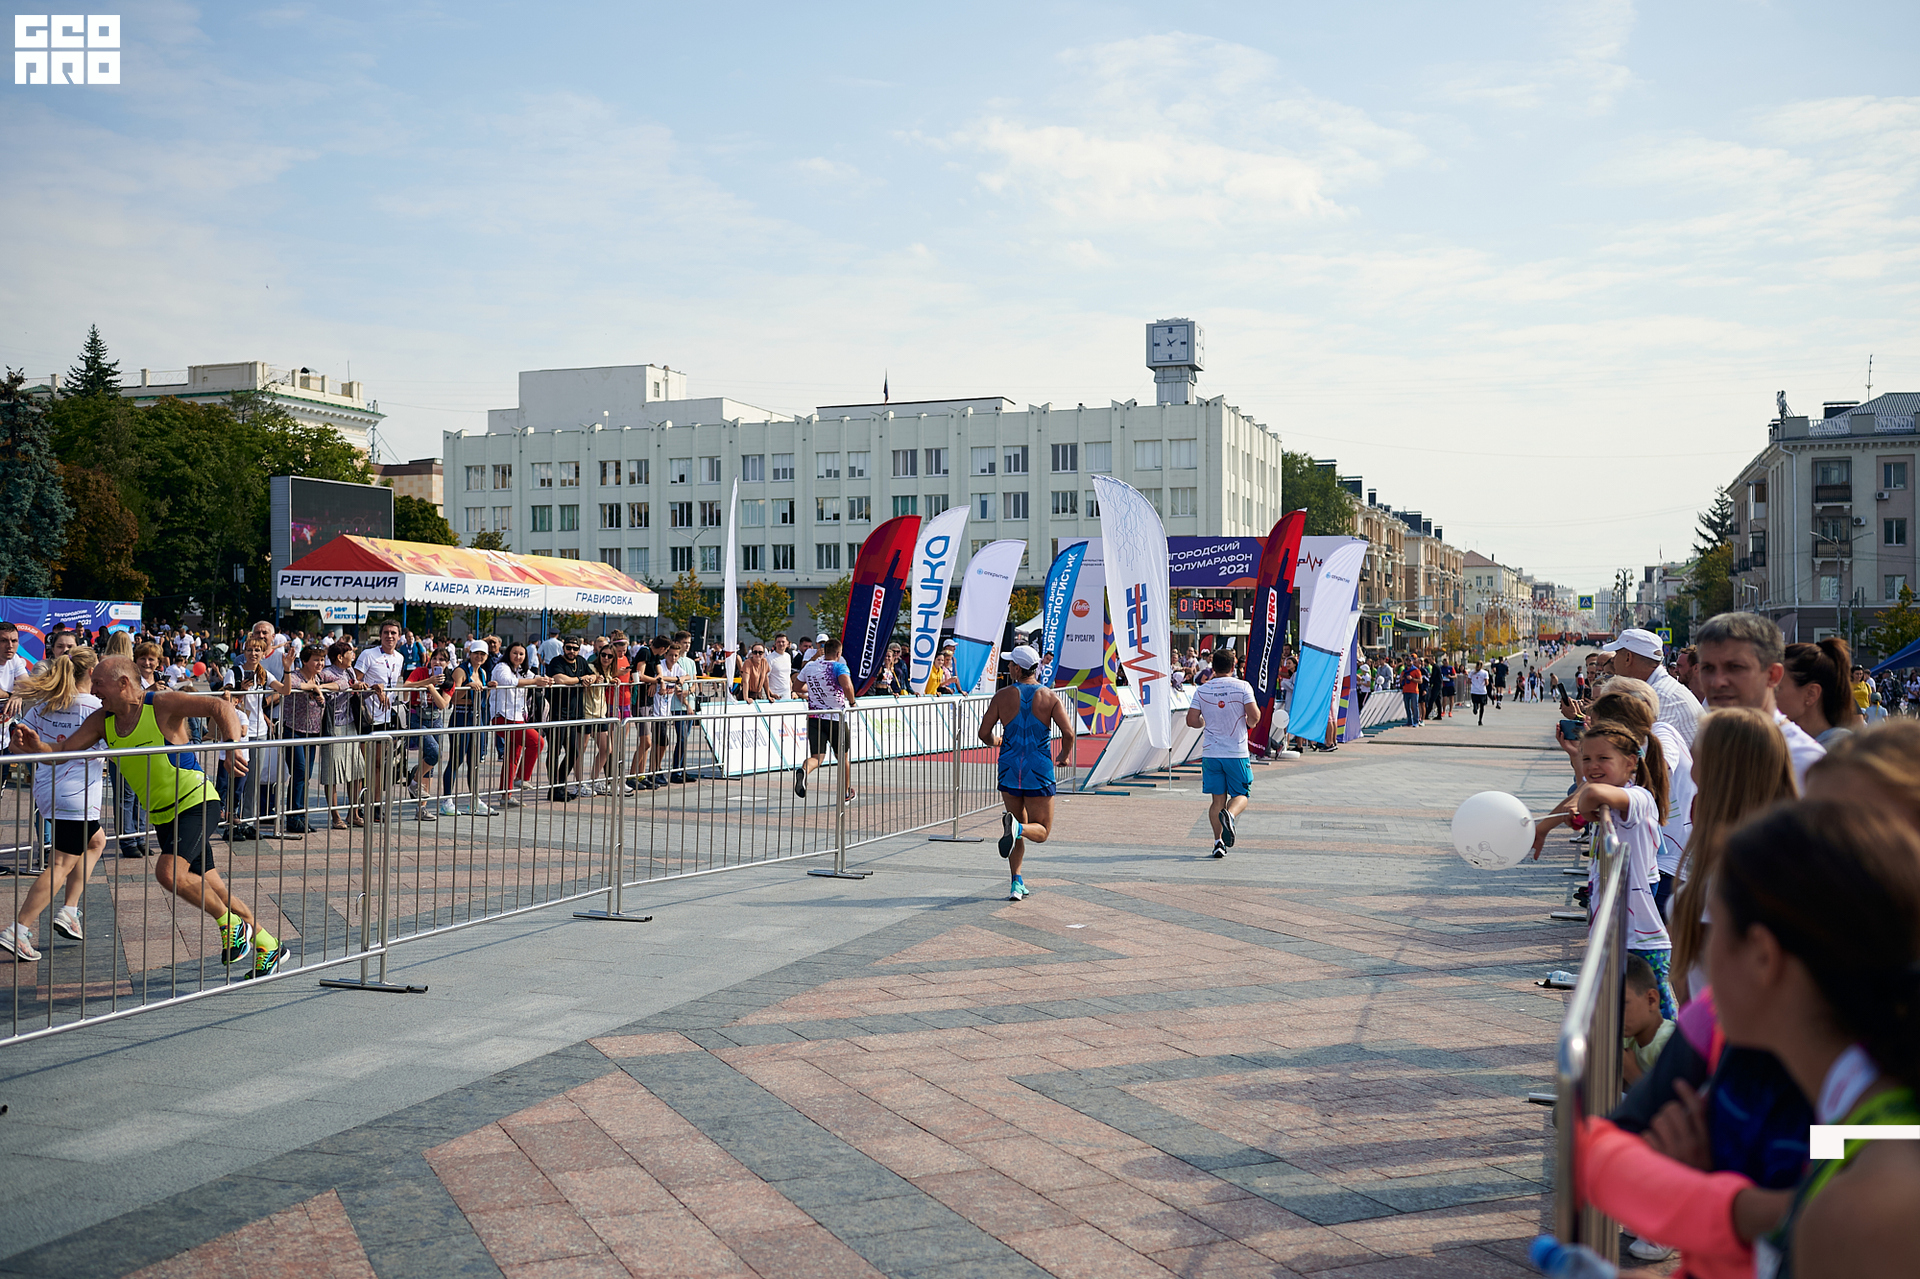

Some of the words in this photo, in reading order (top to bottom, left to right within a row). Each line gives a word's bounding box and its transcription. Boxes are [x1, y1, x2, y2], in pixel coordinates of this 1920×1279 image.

[1218, 564, 1249, 576] 2021
[280, 575, 398, 589] РЕГИСТРАЦИЯ
[424, 580, 470, 594] КАМЕРА
[475, 584, 530, 598] ХРАНЕНИЯ
[575, 592, 633, 605] ГРАВИРОВКА
[1180, 599, 1232, 612] 01:05:45
